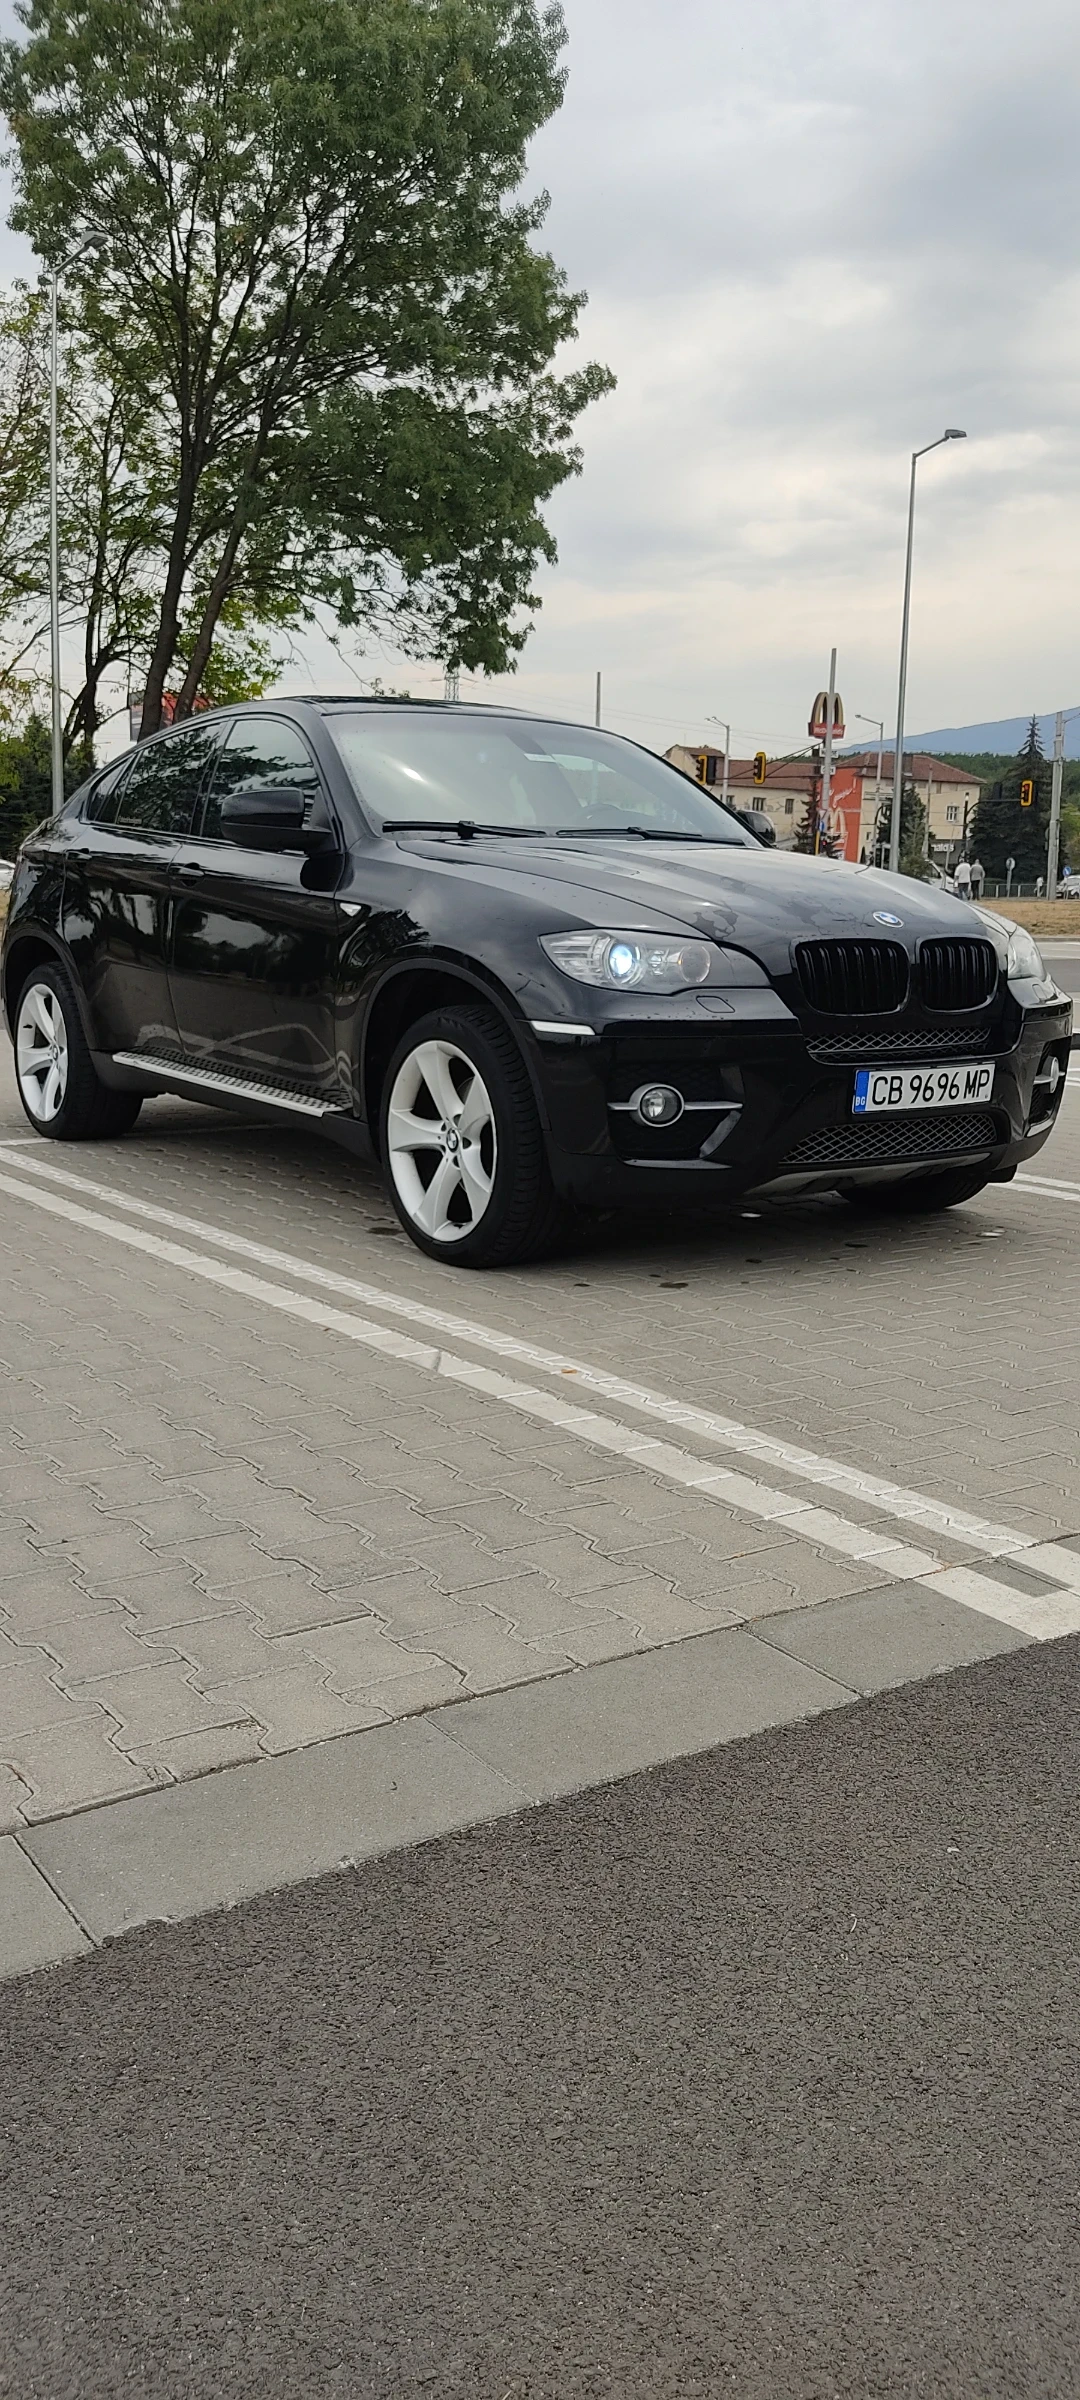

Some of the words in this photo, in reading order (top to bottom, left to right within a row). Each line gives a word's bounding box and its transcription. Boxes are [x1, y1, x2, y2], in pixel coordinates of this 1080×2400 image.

[872, 1076, 903, 1106] CB
[909, 1072, 960, 1104] 9696
[963, 1069, 990, 1099] MP
[855, 1096, 866, 1106] BG
